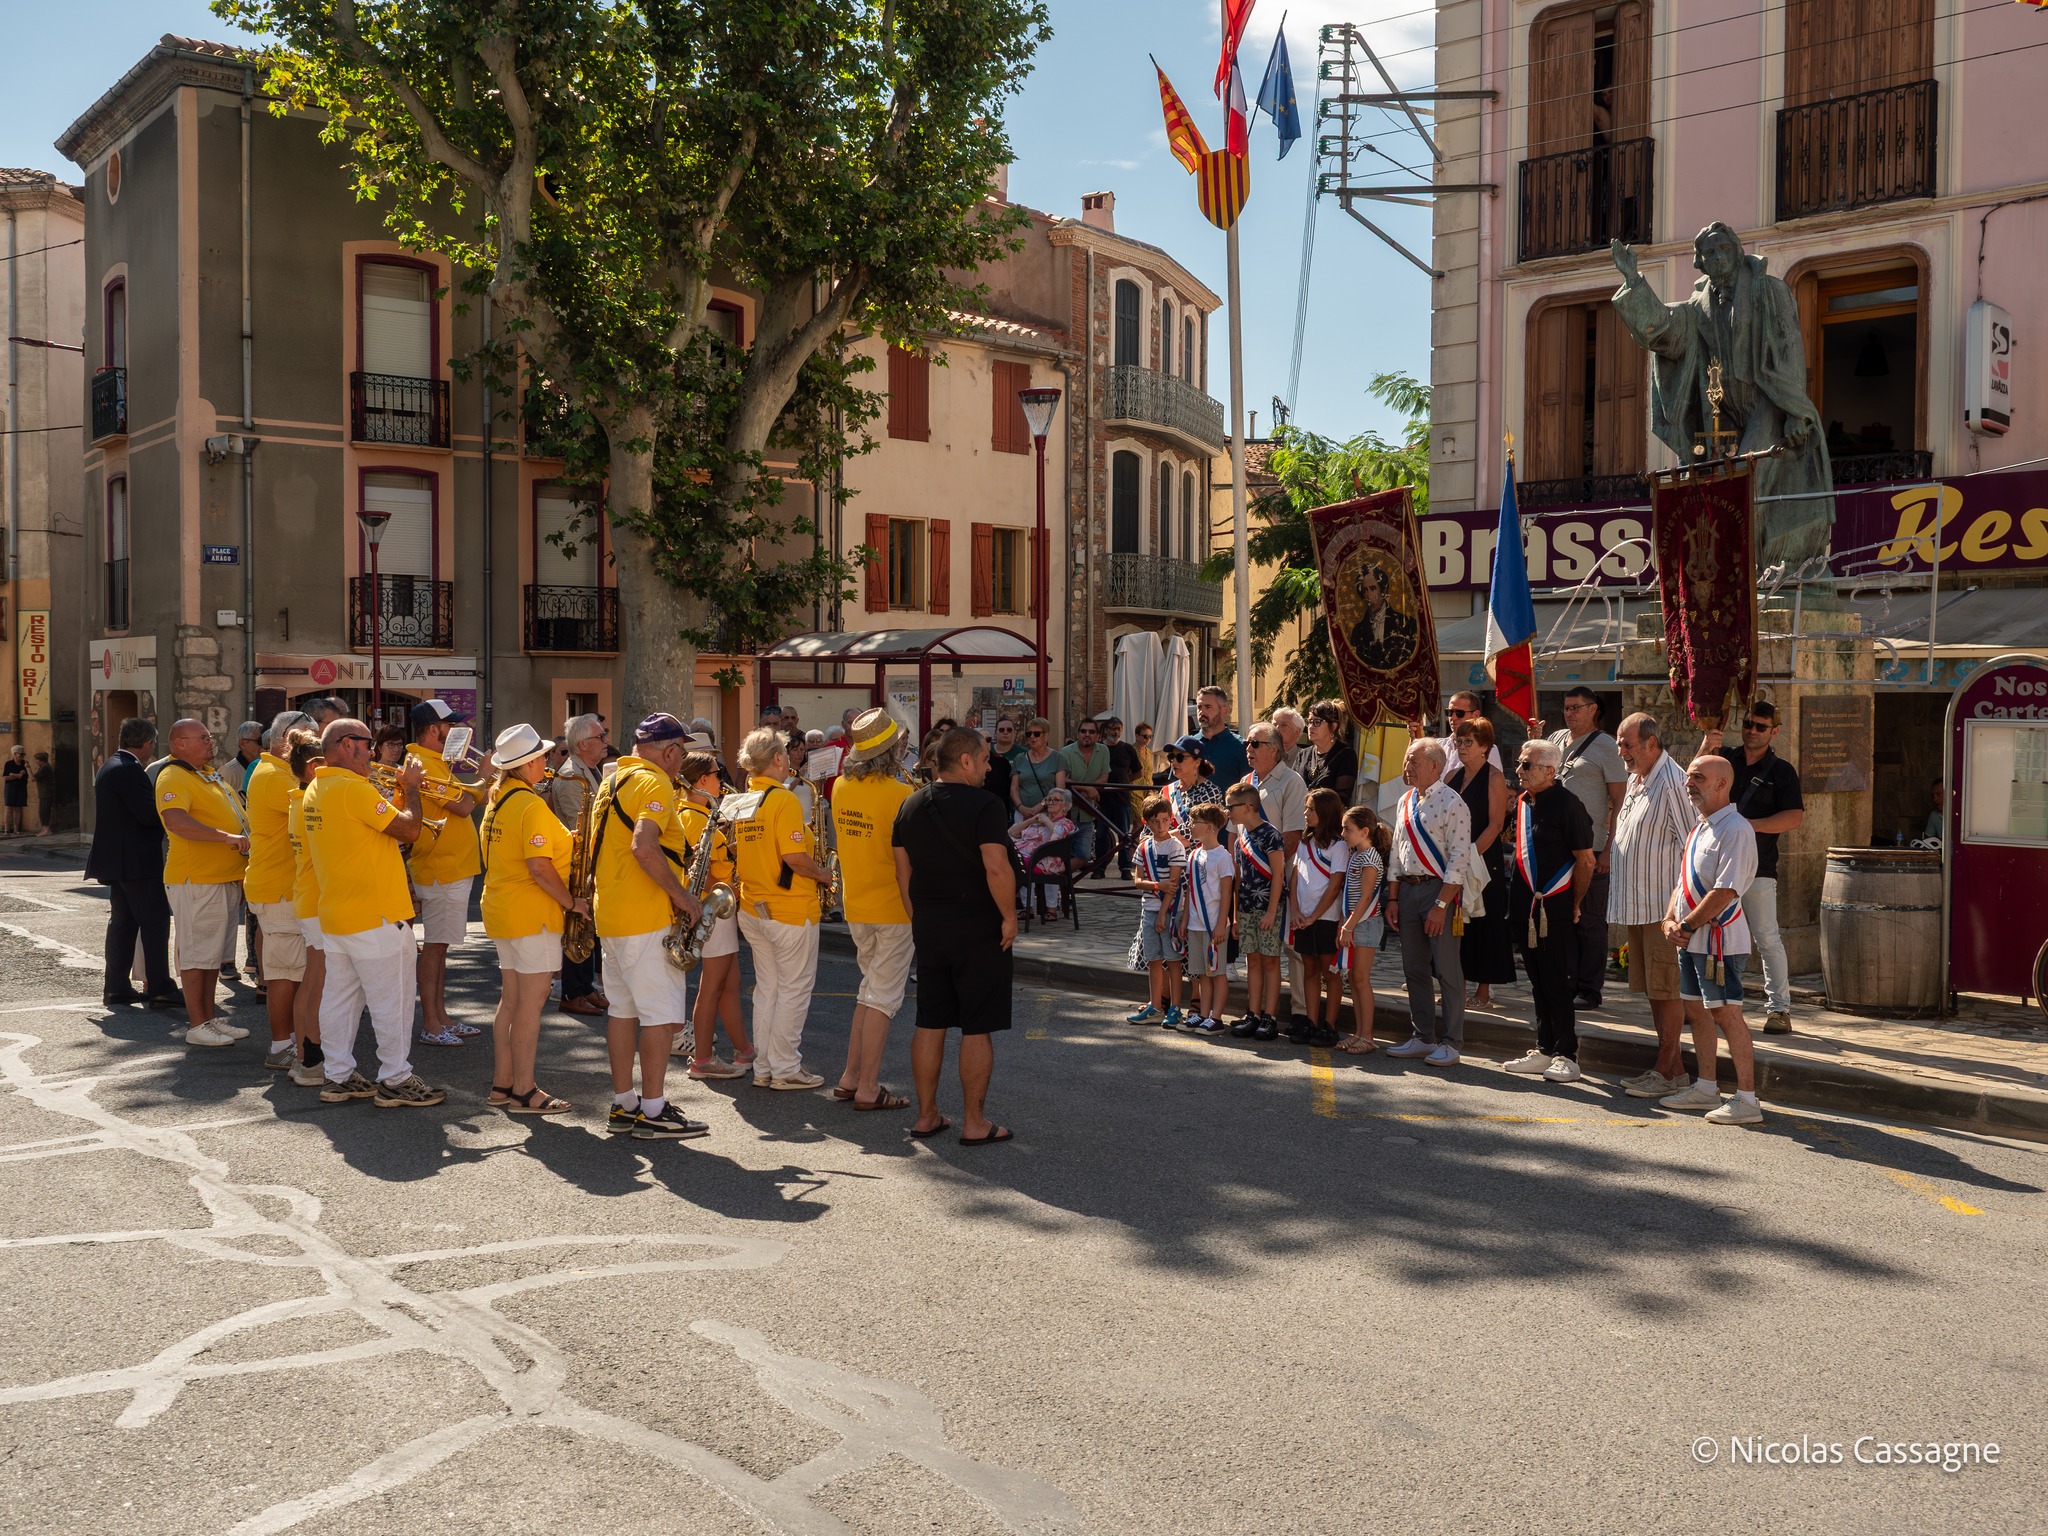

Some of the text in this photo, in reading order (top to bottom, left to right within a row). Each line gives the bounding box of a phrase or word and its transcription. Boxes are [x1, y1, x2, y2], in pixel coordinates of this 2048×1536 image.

[1422, 518, 1660, 587] Brass
[30, 615, 45, 663] RESTO
[23, 668, 38, 716] GRILL
[1005, 680, 1023, 690] 9 17
[1993, 676, 2047, 697] Nos
[846, 810, 863, 818] BANDA
[846, 819, 874, 830] COMPANYS
[846, 829, 862, 837] CERET
